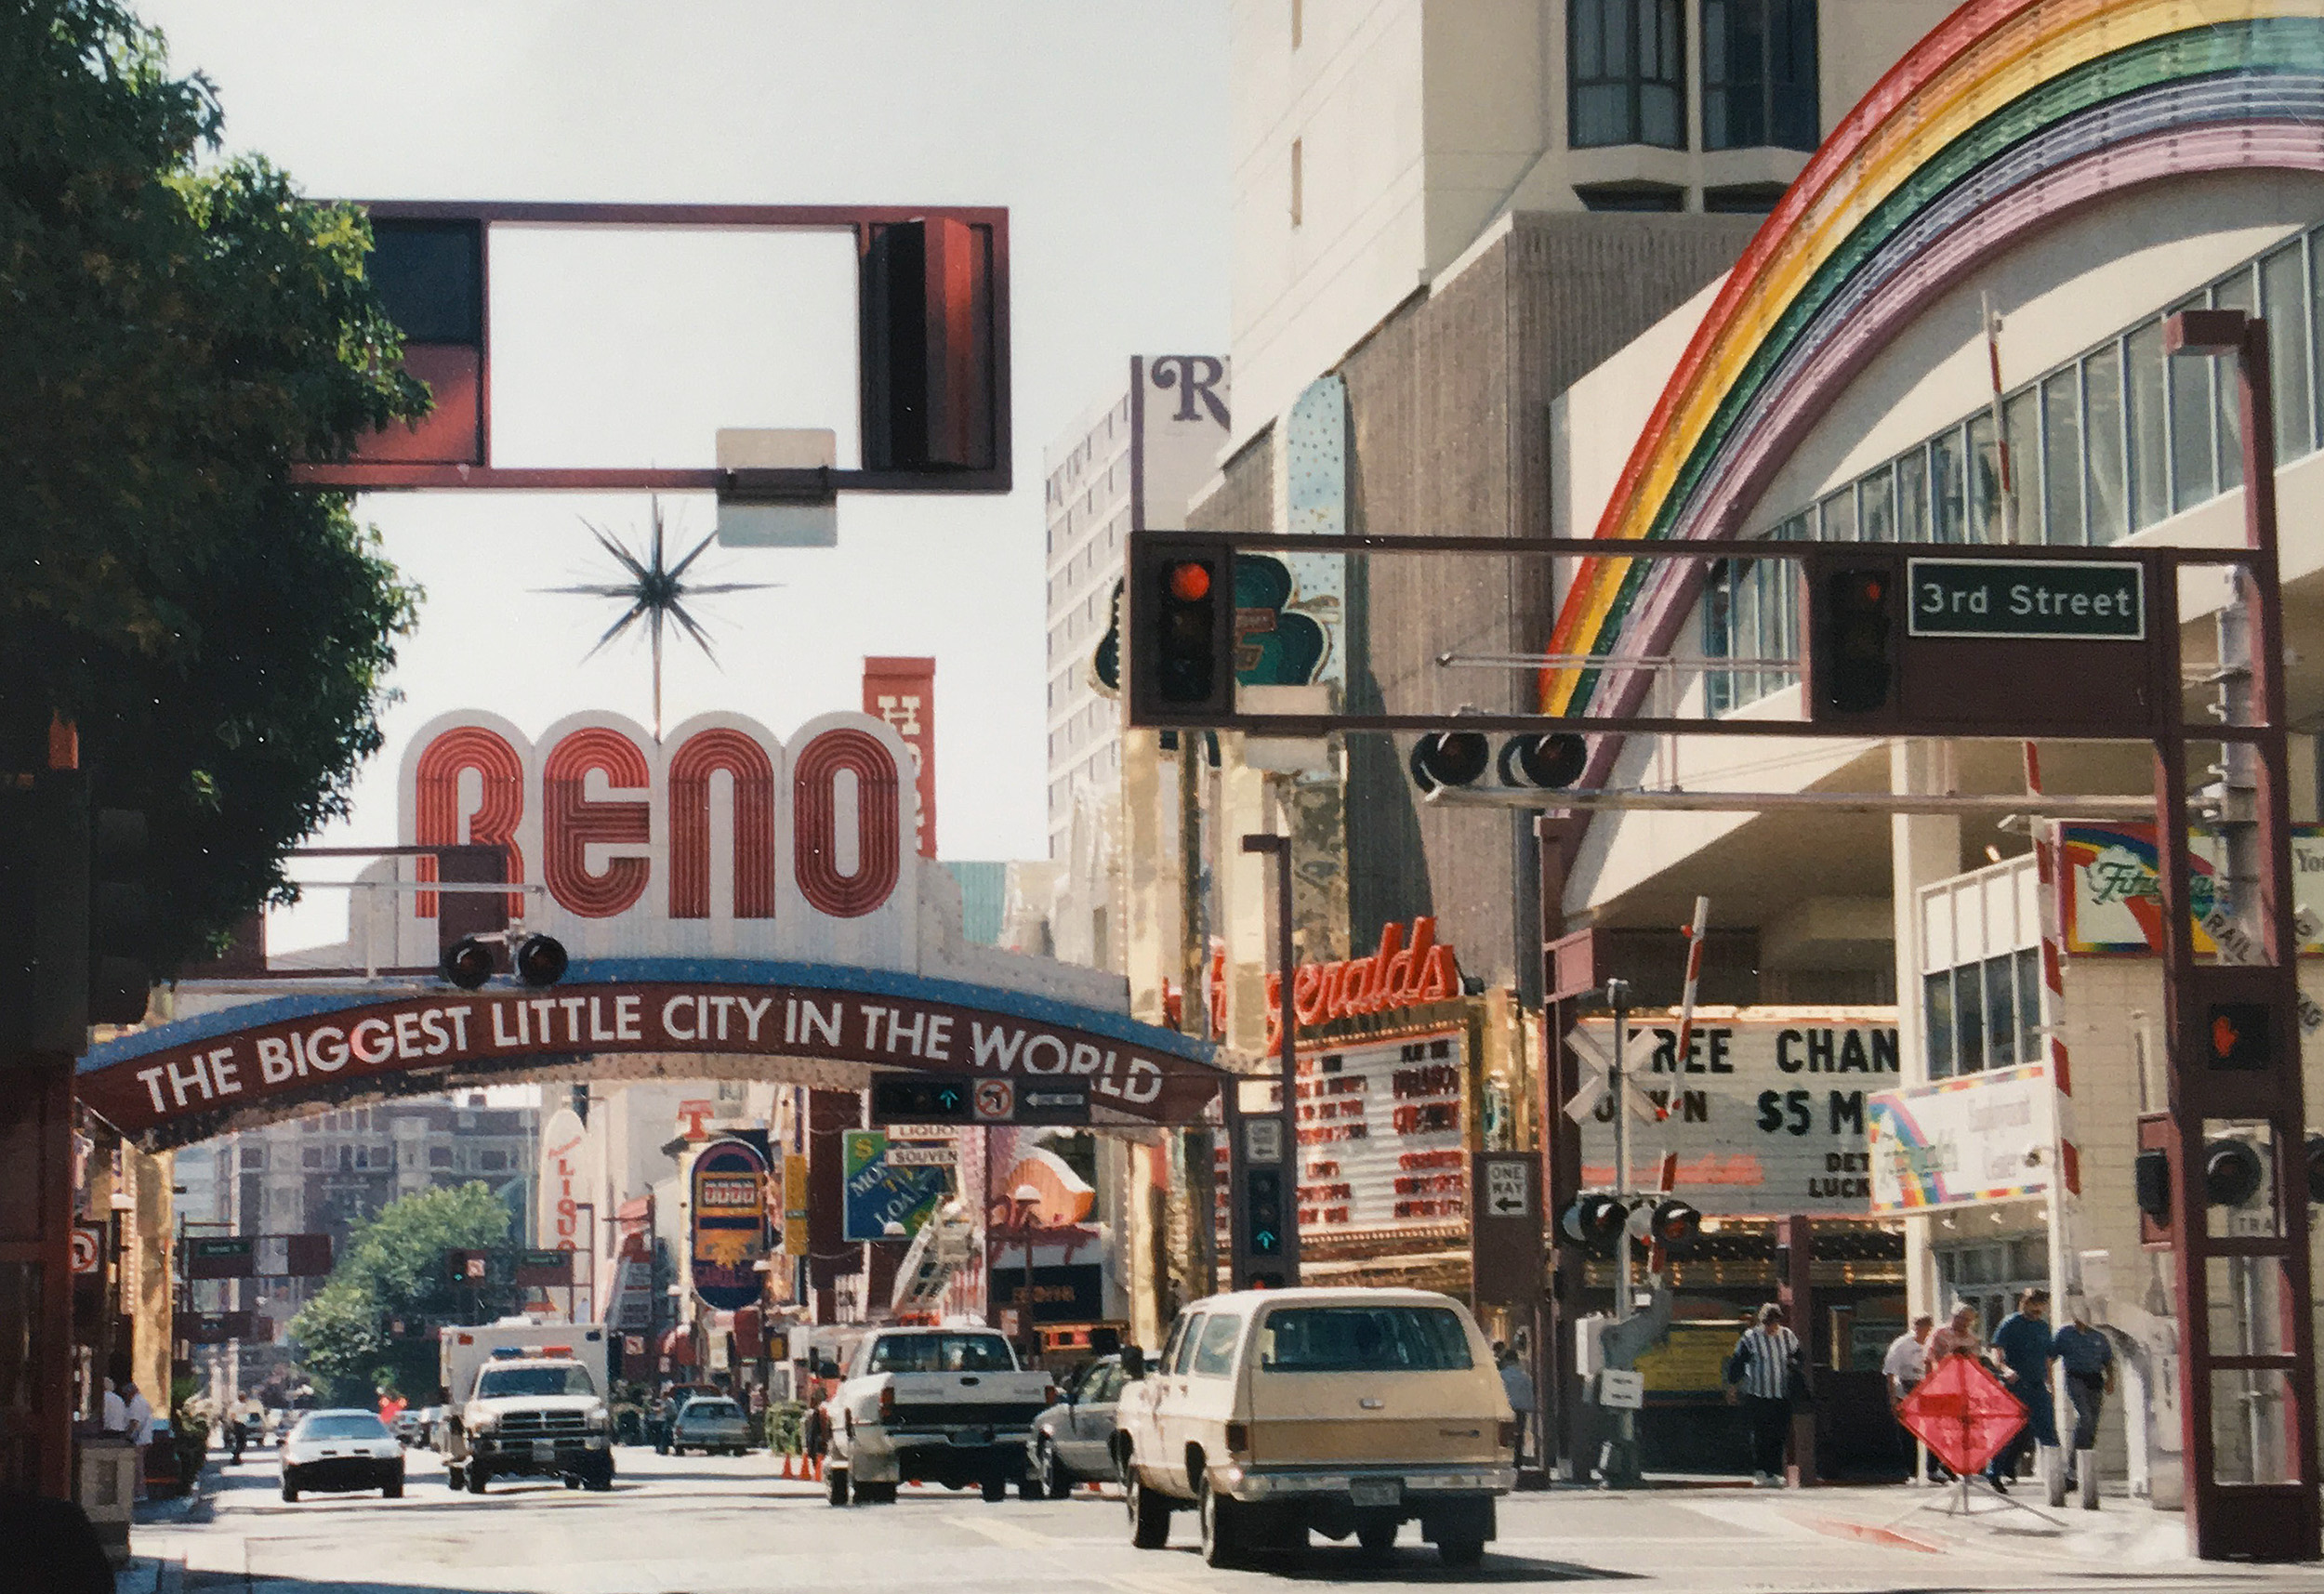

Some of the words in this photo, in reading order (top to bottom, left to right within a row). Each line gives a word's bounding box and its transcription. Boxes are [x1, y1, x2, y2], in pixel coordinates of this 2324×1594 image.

[1921, 582, 1988, 614] 3rd
[2009, 583, 2132, 617] Street
[137, 1047, 244, 1115] THE
[257, 1007, 472, 1087] BIGGEST
[491, 995, 641, 1047] LITTLE
[661, 996, 776, 1042] CITY
[785, 997, 842, 1048] IN
[860, 1005, 953, 1060] THE
[971, 1020, 1164, 1104] WORLD
[1628, 1028, 1734, 1074] REE
[1491, 1166, 1521, 1179] ONE
[1491, 1182, 1523, 1194] WAY
